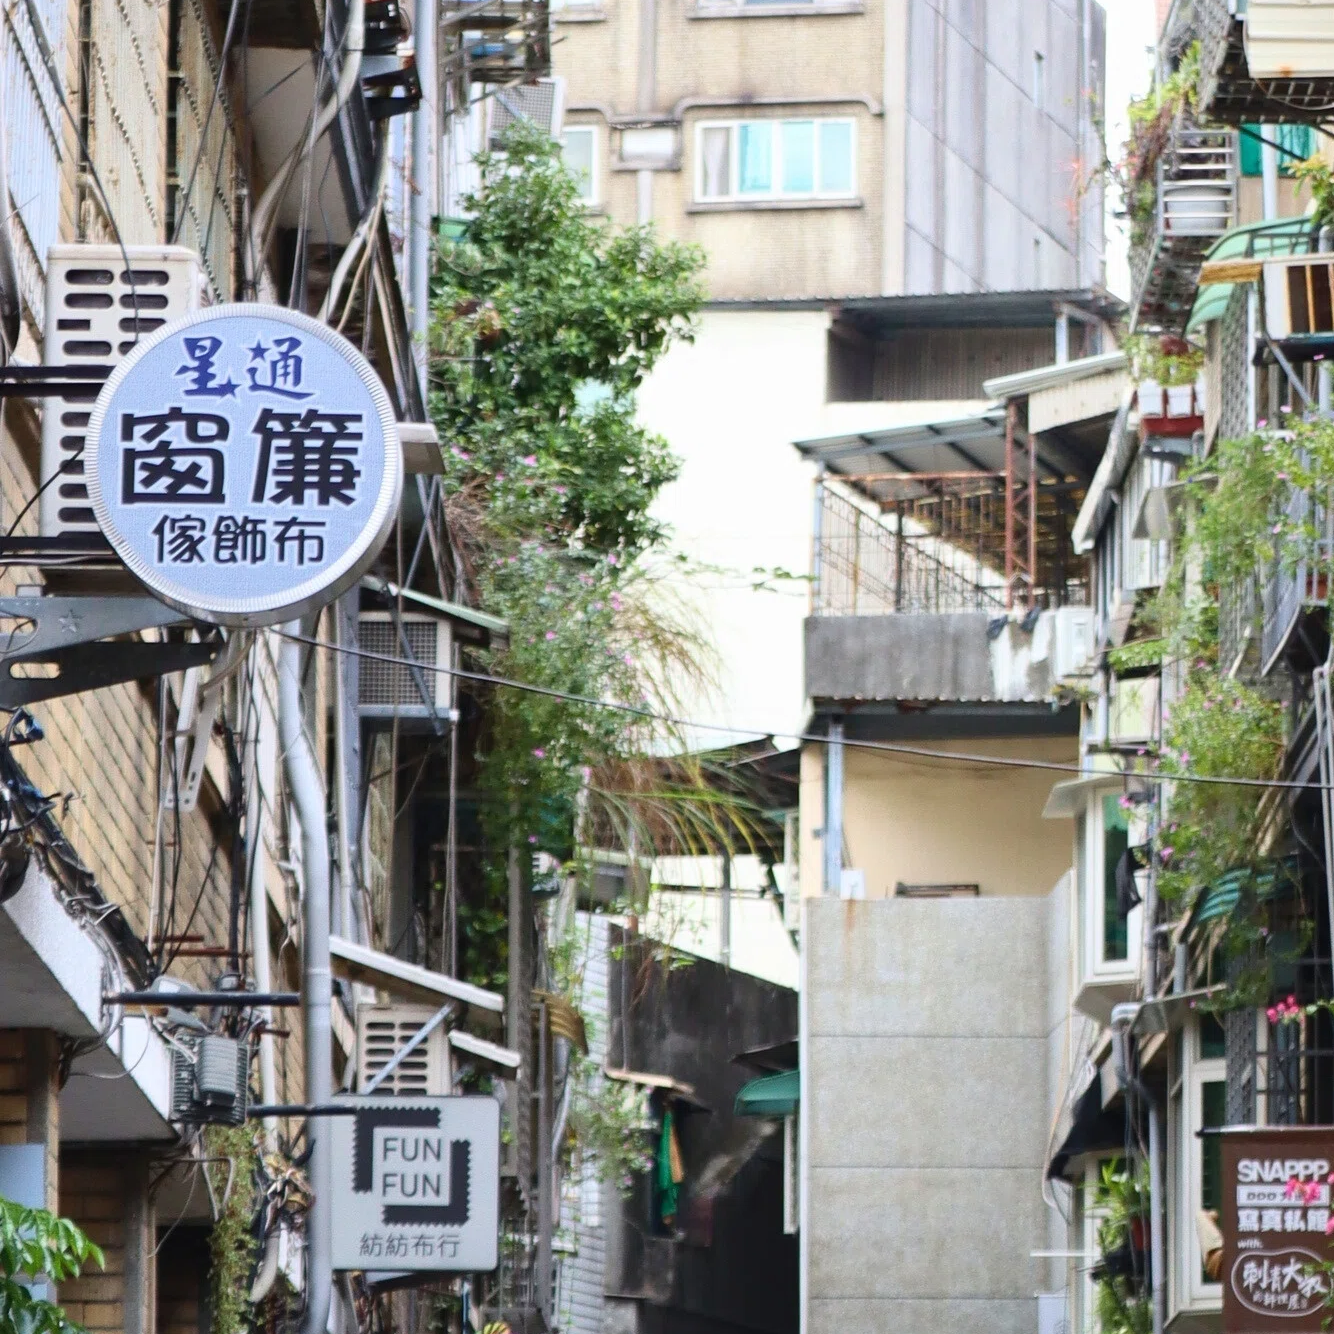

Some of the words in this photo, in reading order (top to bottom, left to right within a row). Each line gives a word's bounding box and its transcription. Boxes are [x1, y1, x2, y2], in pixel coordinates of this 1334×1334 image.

[173, 335, 317, 400] 星通
[152, 514, 327, 566] 傢飾布
[382, 1137, 442, 1162] FUN
[1237, 1159, 1330, 1183] SNAPPP
[381, 1173, 441, 1198] FUN
[359, 1233, 461, 1258] 紡紡布行
